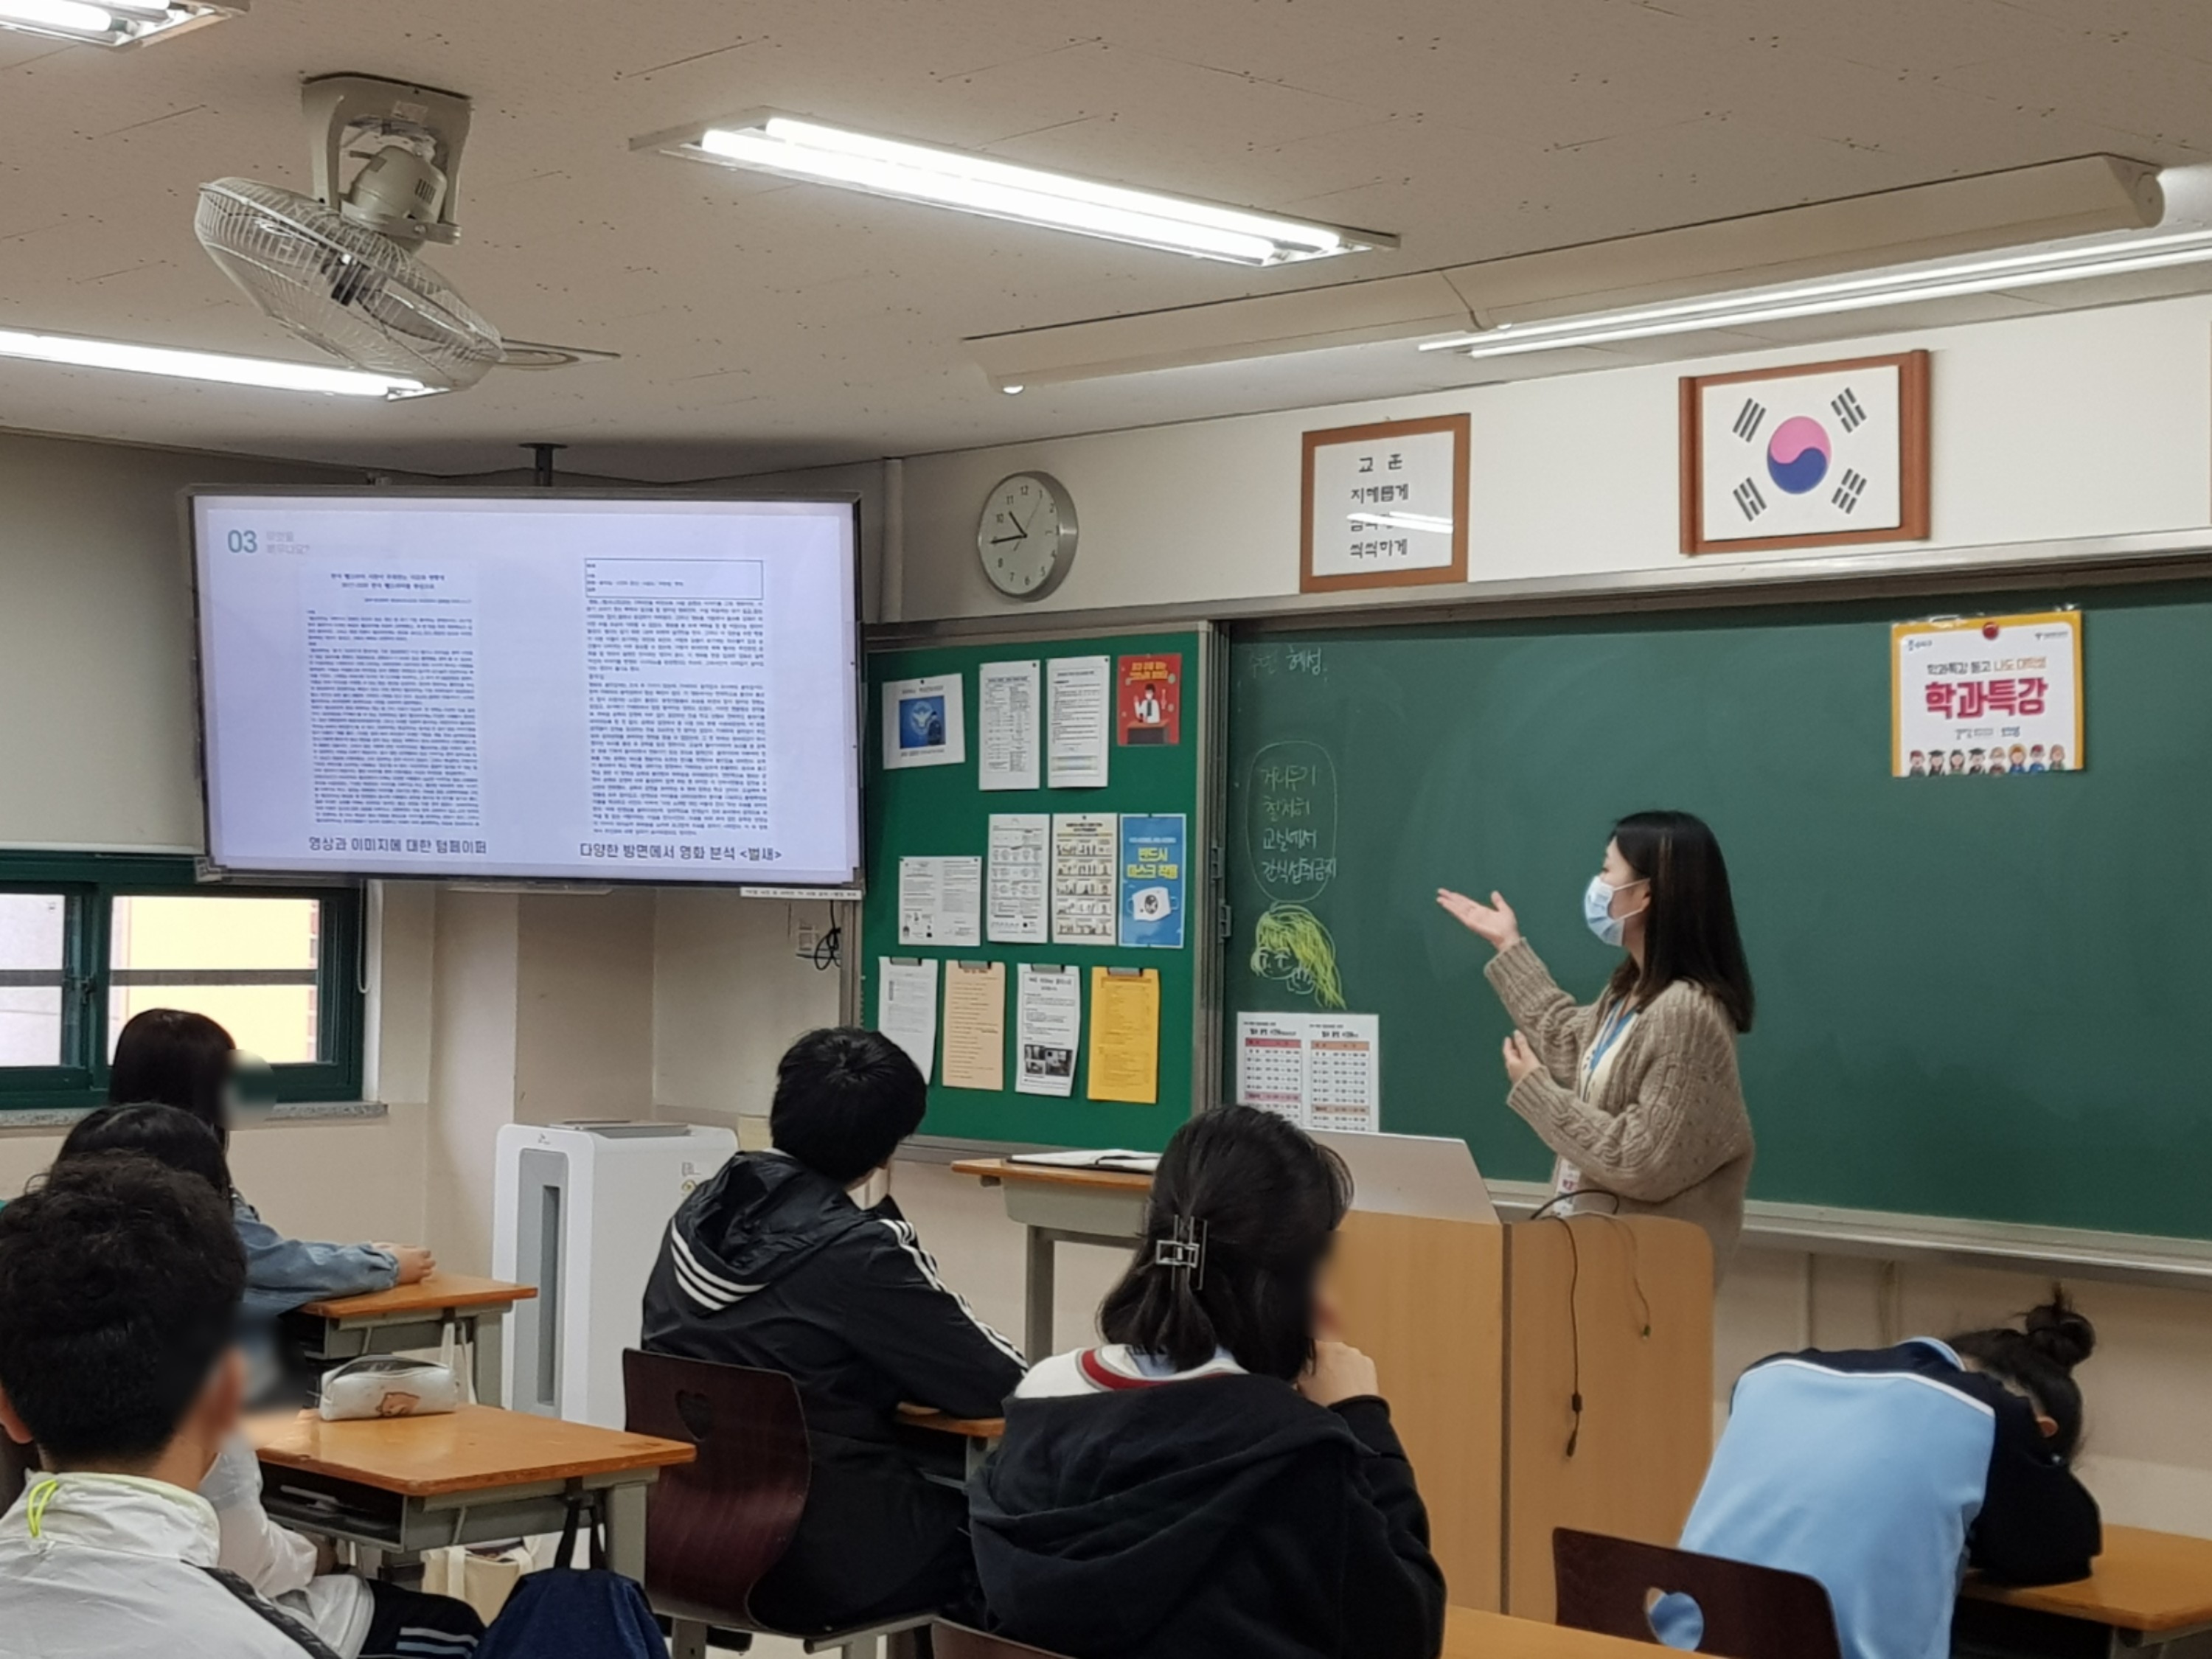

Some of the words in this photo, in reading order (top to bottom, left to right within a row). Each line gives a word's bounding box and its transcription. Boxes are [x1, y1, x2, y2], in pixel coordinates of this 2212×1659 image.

[1006, 495, 1015, 506] 11
[1020, 484, 1029, 496] 12
[1350, 482, 1410, 505] 지혜롭게
[227, 529, 258, 554] 03
[1349, 538, 1409, 560] 씩씩하게
[1924, 676, 2049, 720] 학과특강
[308, 836, 347, 851] 영상과
[351, 837, 402, 852] 이미지에
[406, 838, 431, 854] 대한
[1262, 827, 1317, 853] 교실에서
[580, 843, 619, 858] 다양한
[623, 844, 675, 860] 방면에서
[679, 845, 706, 860] 영화
[709, 846, 736, 862] 분석
